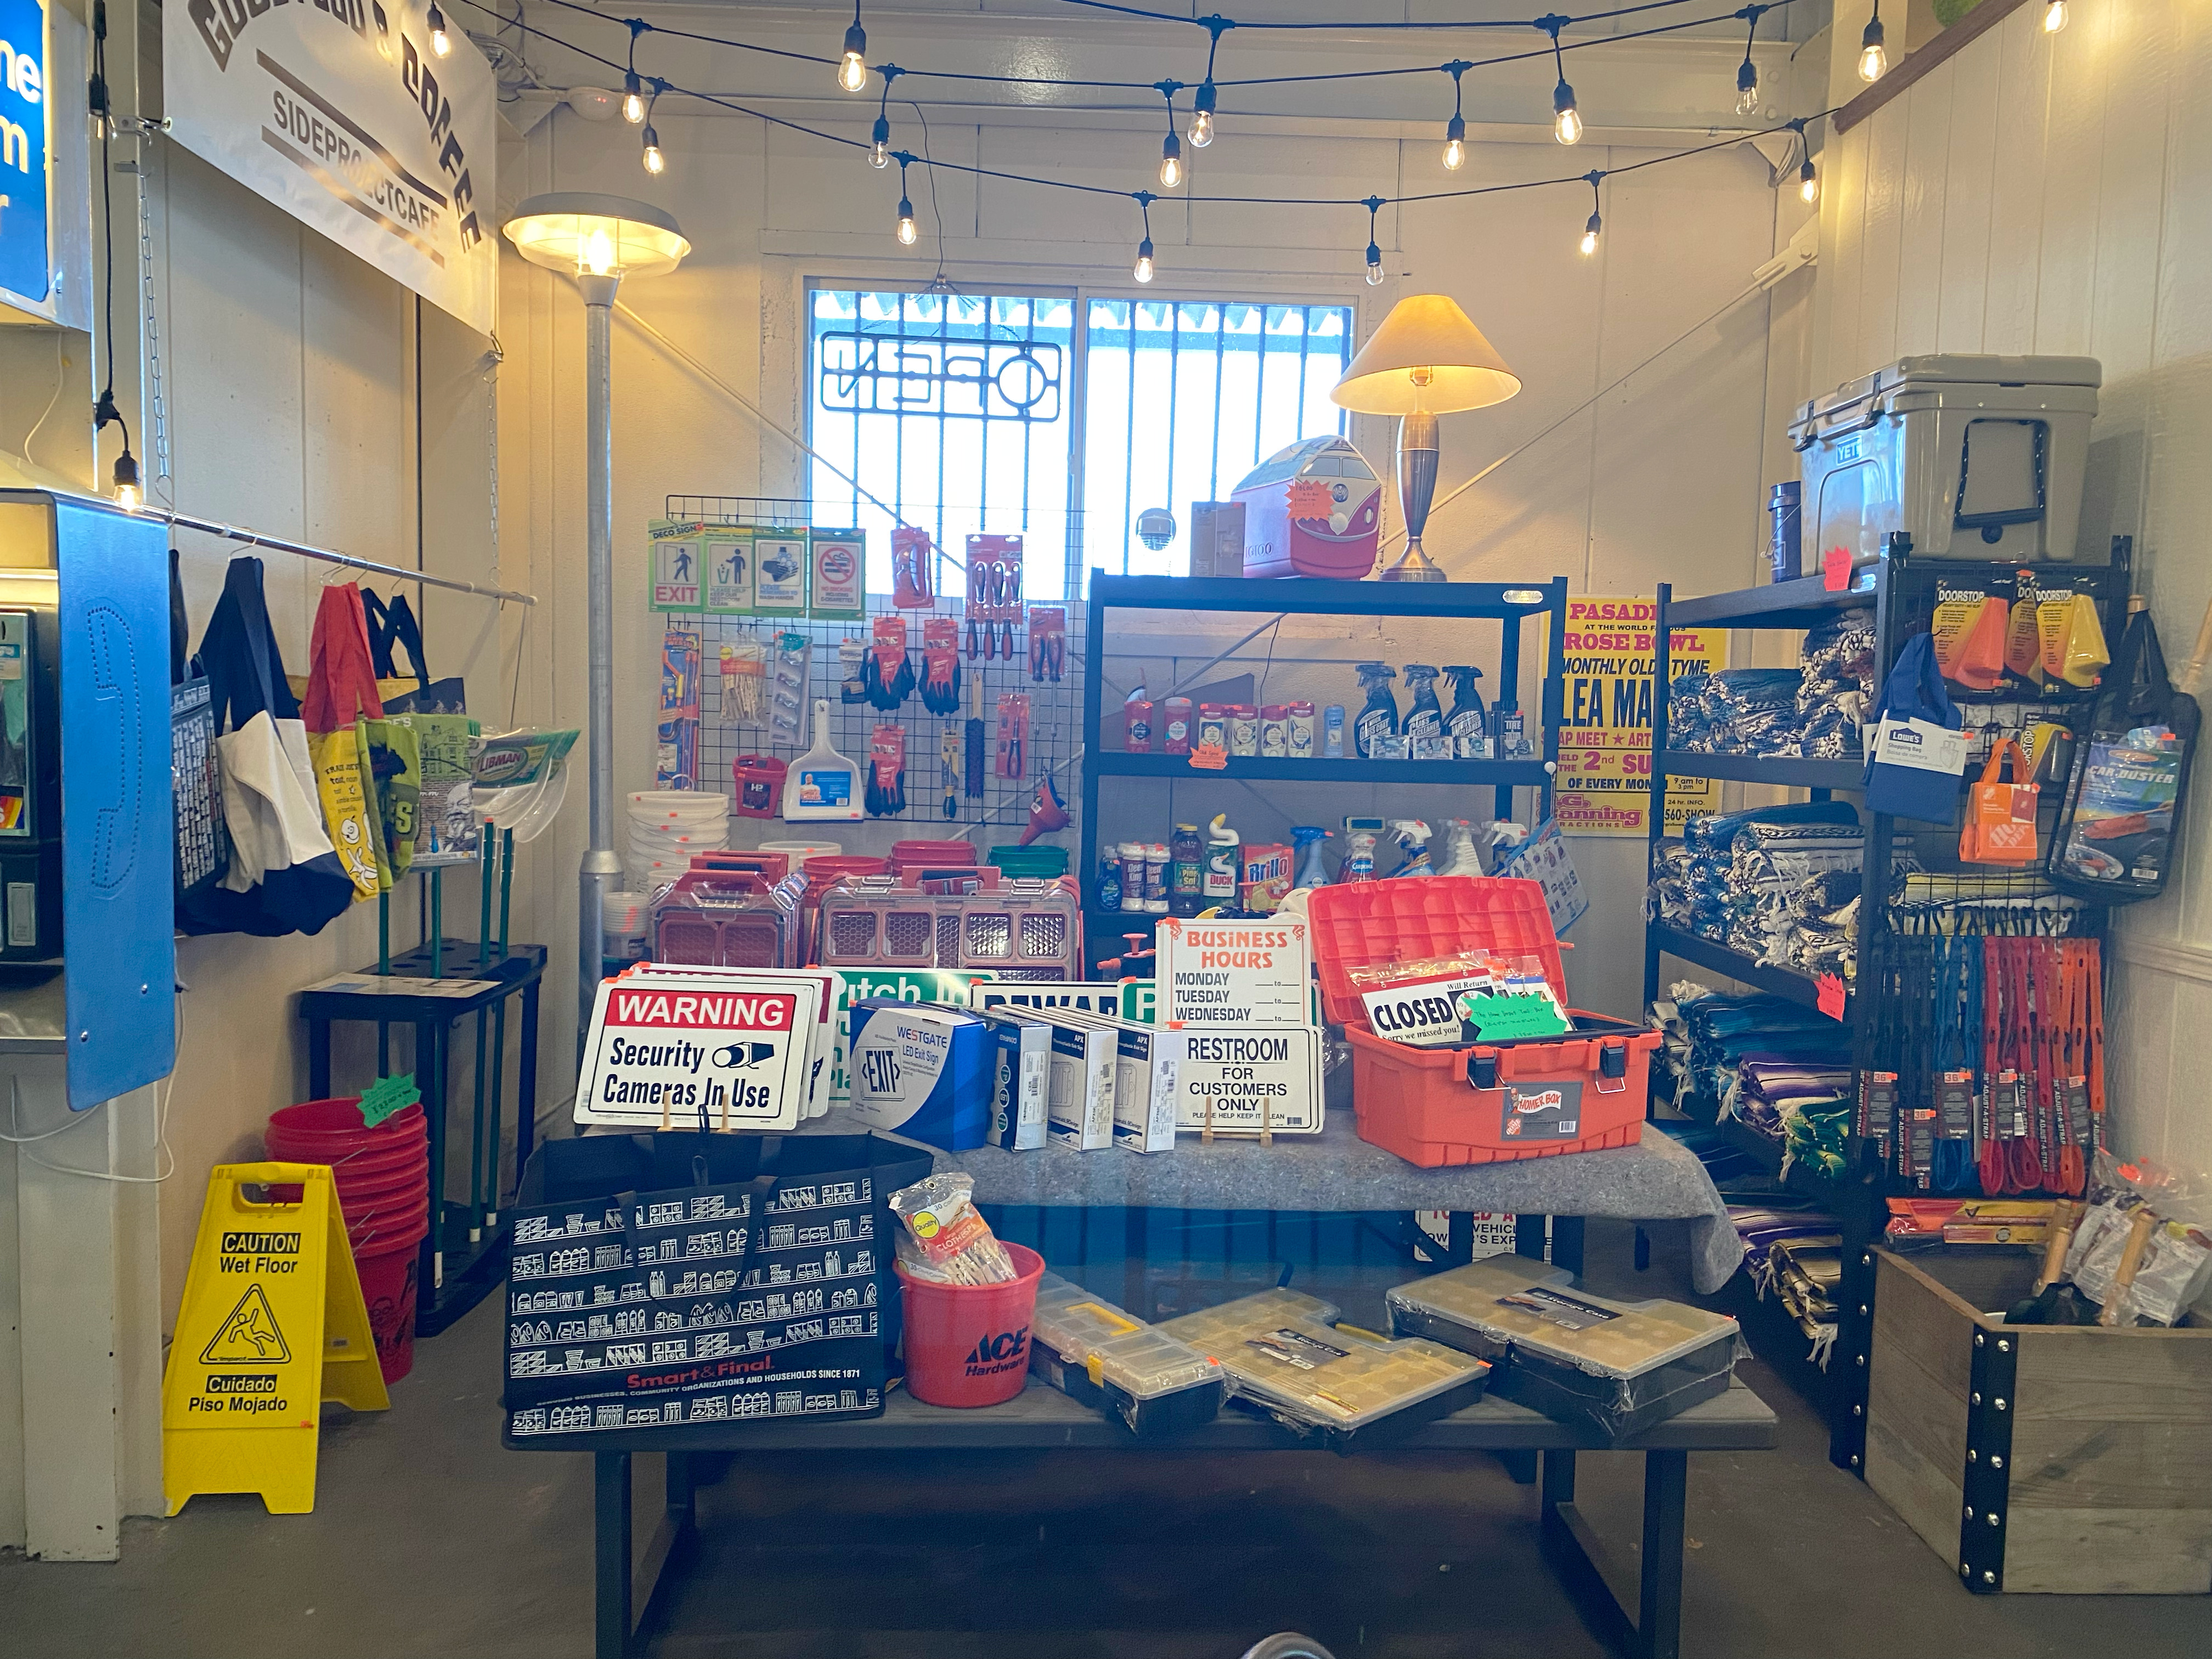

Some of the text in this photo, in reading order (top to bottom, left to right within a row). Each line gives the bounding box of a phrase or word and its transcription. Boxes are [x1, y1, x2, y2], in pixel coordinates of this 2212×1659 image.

[653, 530, 674, 539] DECO
[656, 586, 698, 602] EXIT
[1938, 590, 1984, 602] DOORSTOP
[2036, 590, 2072, 601] DOORSTOP
[1564, 633, 1629, 650] ROSE
[1672, 659, 1709, 675] TYME
[1504, 720, 1521, 730] TIRE
[1577, 732, 1607, 745] MEET
[1893, 731, 1920, 743] LOWE'S
[479, 753, 521, 772] LIBMAN
[1584, 751, 1615, 771] 2nd
[2090, 766, 2175, 784] CAR DUSTER
[1568, 778, 1622, 789] OF EVERY
[1537, 806, 1642, 828] anning
[1248, 857, 1289, 883] Brillo
[1210, 874, 1233, 885] DUCK
[1201, 952, 1273, 969] HOURS
[1175, 973, 1229, 986] MONDAY
[1447, 978, 1488, 991] Will Return
[1175, 990, 1229, 1003] TUESDAY
[618, 996, 784, 1026] WARNING
[1175, 1008, 1251, 1021] WEDNESDAY
[1374, 997, 1453, 1032] CLOSED
[897, 1026, 947, 1048] WESTGATE
[1417, 1026, 1441, 1038] missed
[1443, 1025, 1460, 1036] you!
[1137, 1036, 1147, 1045] APX
[610, 1037, 705, 1074] Security
[902, 1045, 938, 1065] LED Exit Sign
[1188, 1038, 1288, 1061] RESTROOM
[866, 1051, 896, 1092] EXIT
[1222, 1068, 1253, 1080] FOR
[603, 1074, 770, 1108] Cameras In Use
[1189, 1082, 1286, 1096] CUSTOMERS
[1217, 1098, 1259, 1111] ONLY
[1519, 1093, 1561, 1110] HOMER BOX
[915, 1219, 937, 1232] Quality
[224, 1234, 298, 1253] CAUTION
[220, 1257, 297, 1273] Wet Floor
[964, 1326, 1028, 1363] ACE
[965, 1356, 1025, 1376] Hardware
[208, 1377, 275, 1392] Cuidado
[629, 1387, 680, 1396] COMMUNITY
[681, 1378, 744, 1392] ORGANIZATIONS
[746, 1375, 762, 1384] AND
[765, 1370, 816, 1382] HOUSEHOLDS
[819, 1370, 840, 1378] SINCE
[842, 1369, 860, 1378] 1871
[189, 1397, 287, 1413] Piso Mojado
